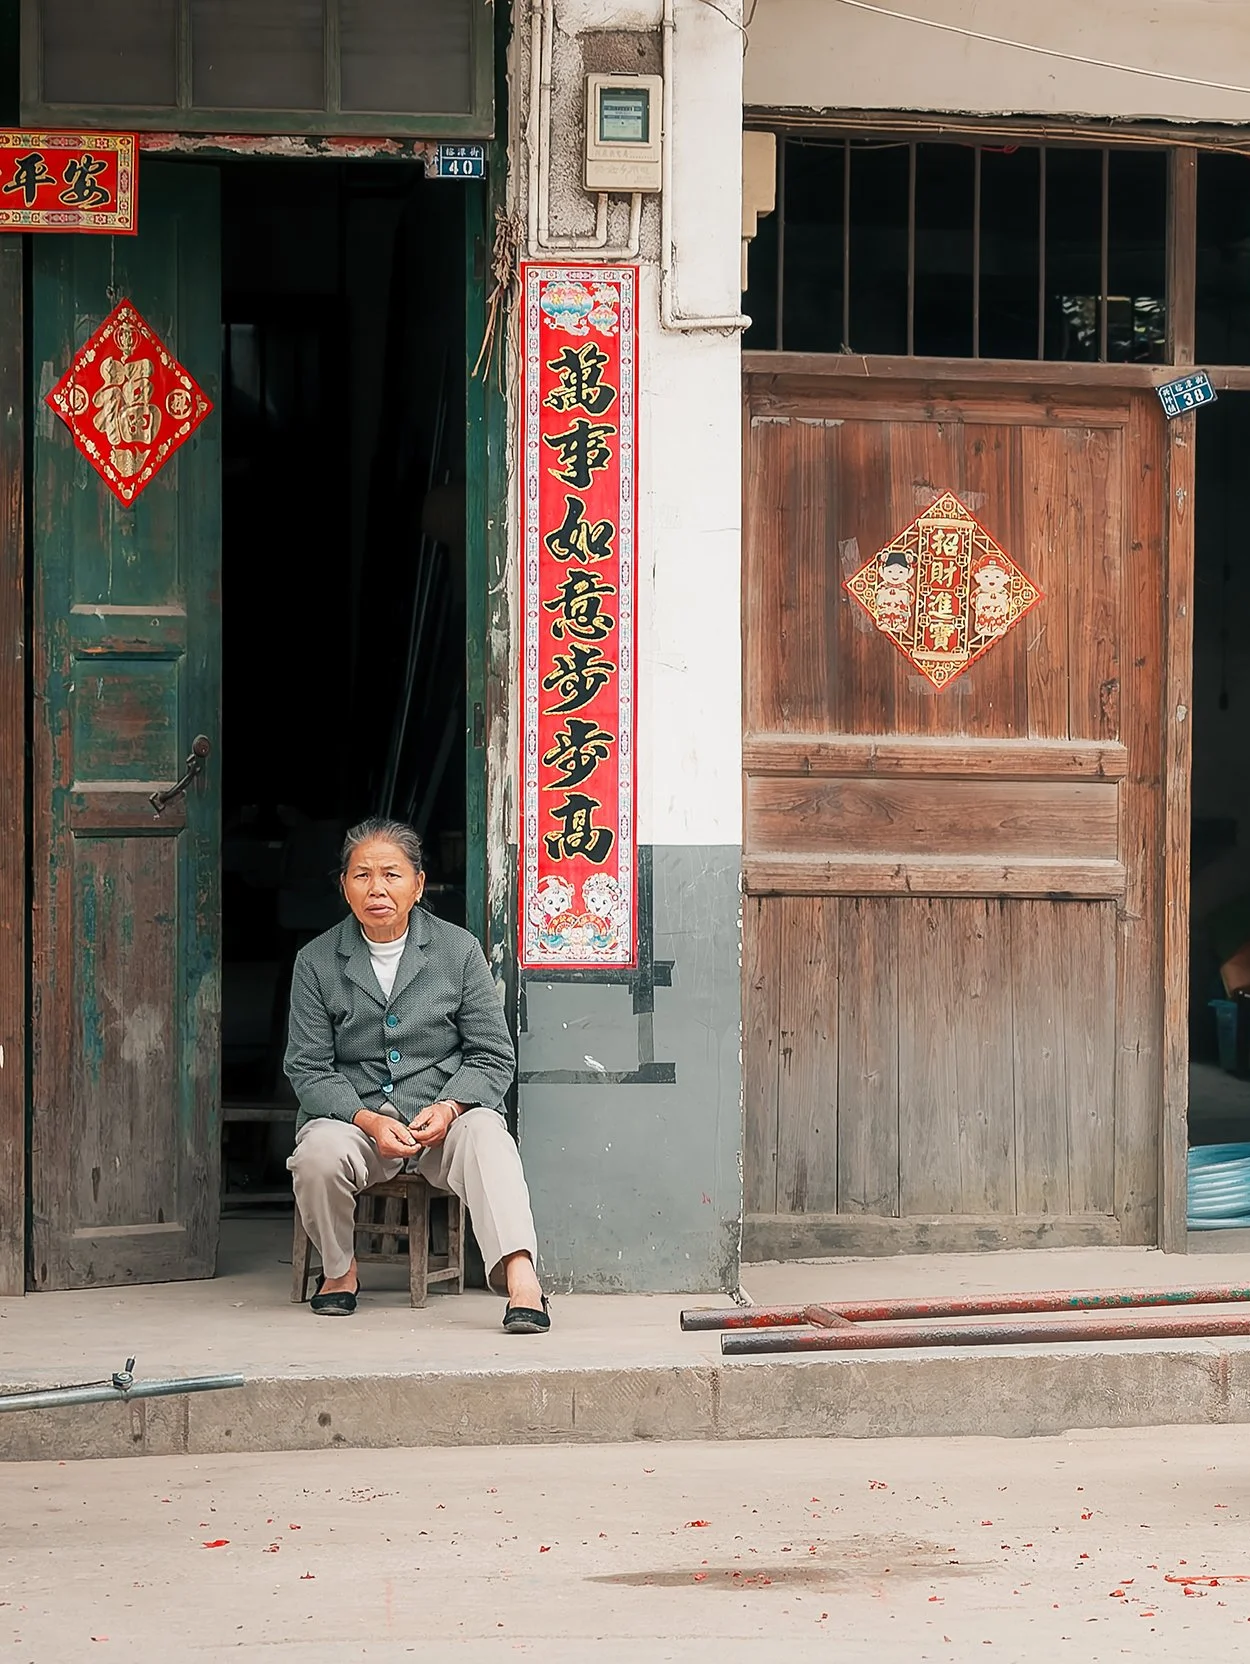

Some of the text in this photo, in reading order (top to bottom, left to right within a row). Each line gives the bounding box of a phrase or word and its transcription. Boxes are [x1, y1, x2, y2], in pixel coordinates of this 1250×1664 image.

[3, 152, 111, 208] 平安
[449, 160, 473, 175] 40
[92, 356, 162, 445] 福
[1183, 388, 1204, 406] 38
[542, 343, 618, 864] 萬事如意步步高
